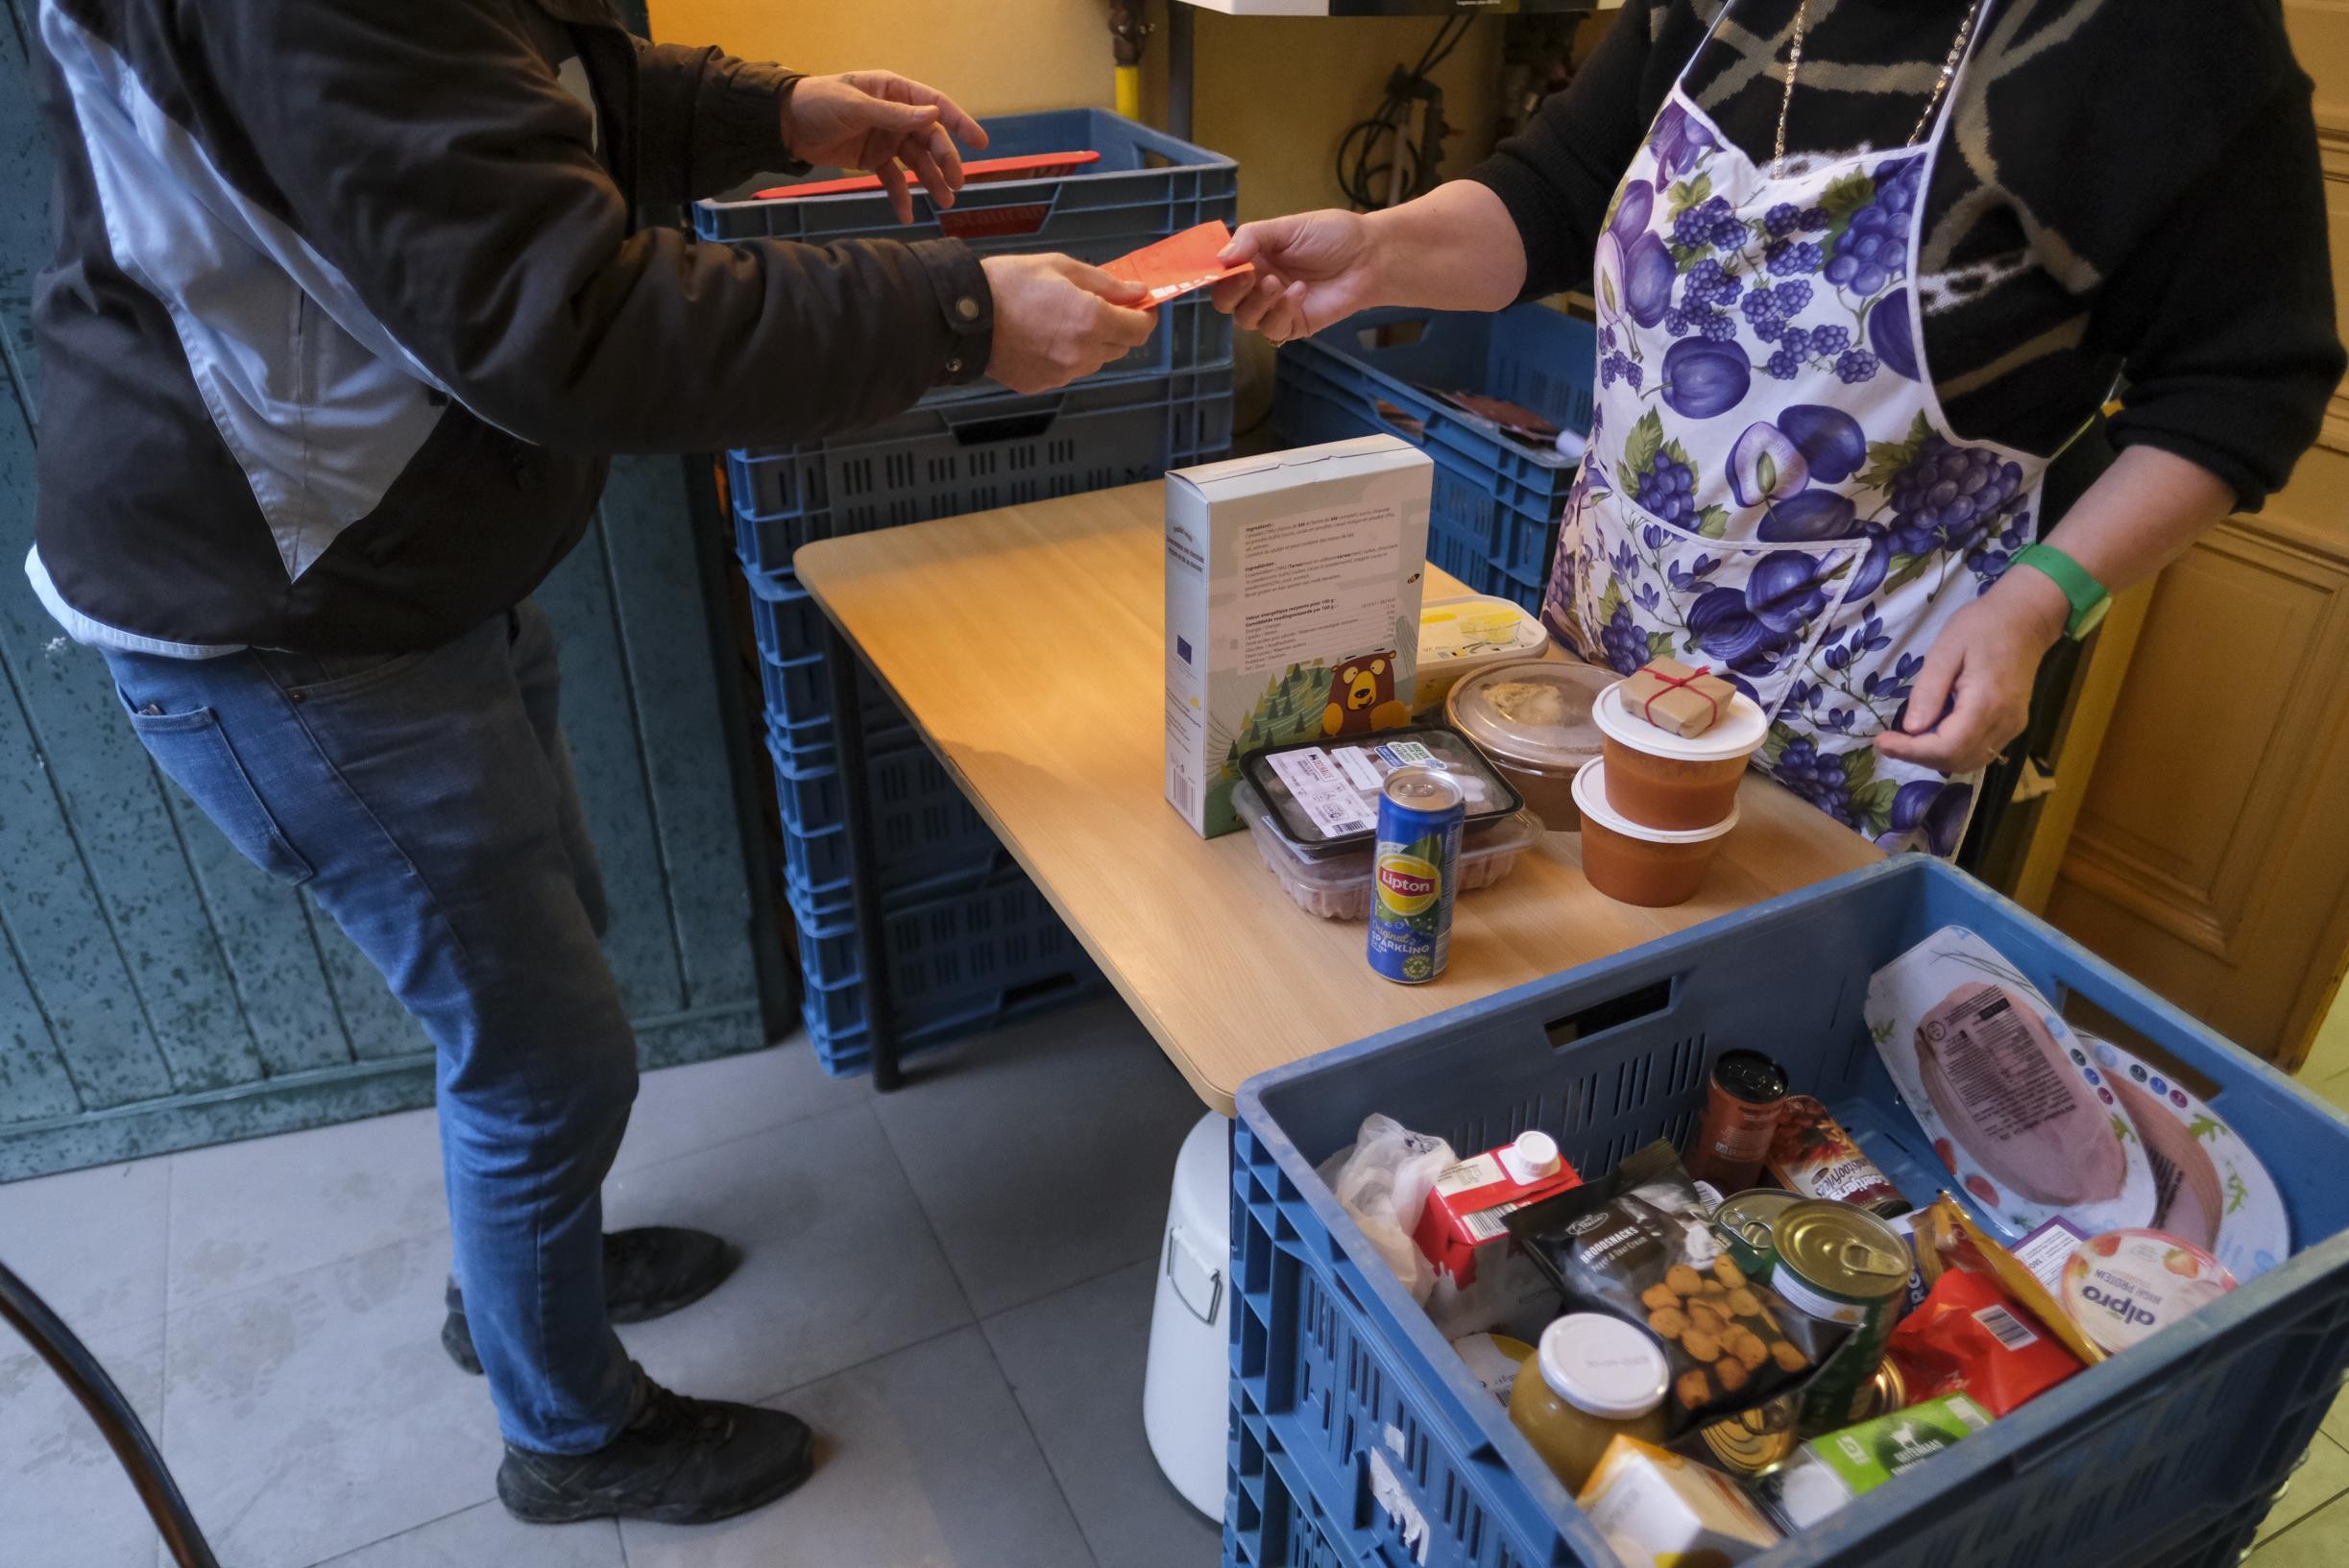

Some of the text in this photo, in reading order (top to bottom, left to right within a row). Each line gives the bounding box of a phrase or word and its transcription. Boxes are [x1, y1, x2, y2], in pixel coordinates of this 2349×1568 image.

[1382, 870, 1431, 892] Lipton
[1371, 929, 1430, 954] SPARKLING
[2095, 1268, 2135, 1293] PROTEIN
[2082, 1286, 2155, 1326] alpro
